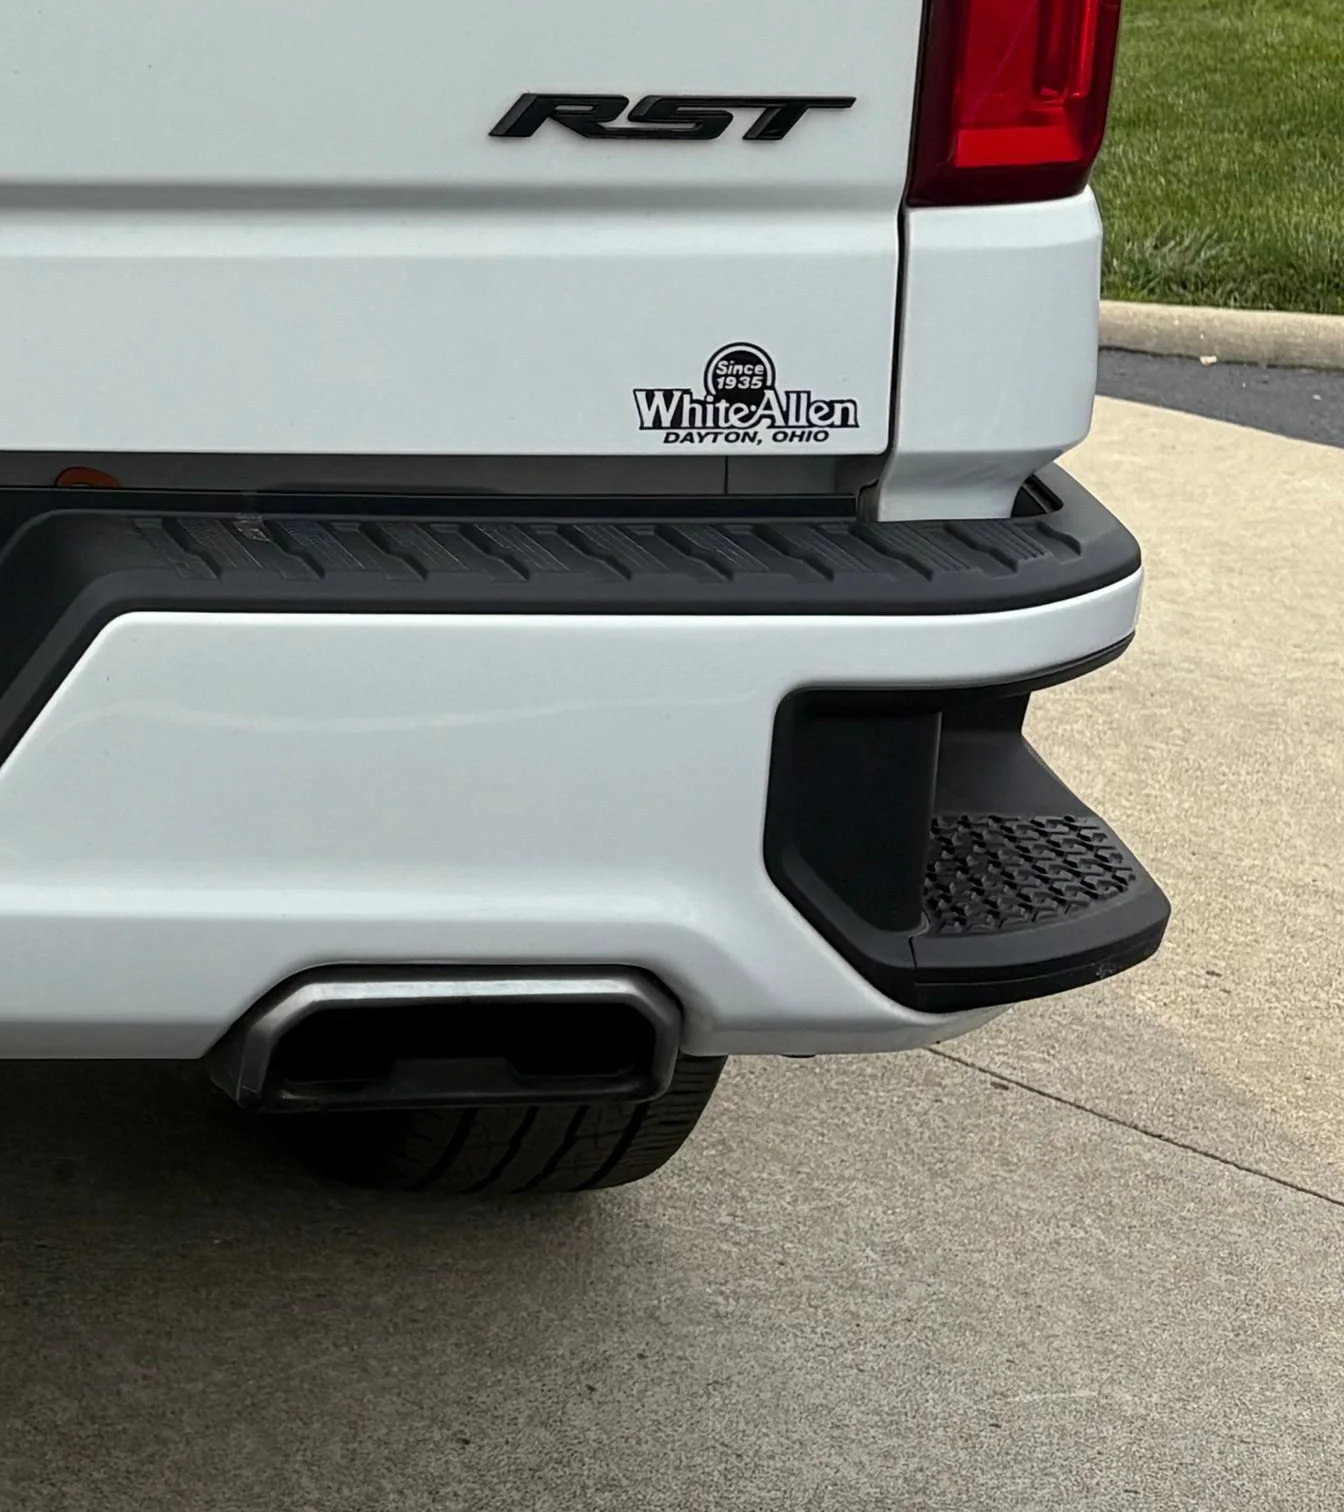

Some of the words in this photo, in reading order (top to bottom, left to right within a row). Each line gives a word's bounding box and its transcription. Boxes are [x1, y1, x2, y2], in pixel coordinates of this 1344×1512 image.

[488, 93, 857, 140] RST
[716, 360, 765, 376] Since
[716, 376, 763, 389] 1935
[663, 431, 763, 445] DAYTON,
[772, 430, 830, 443] OHIO
